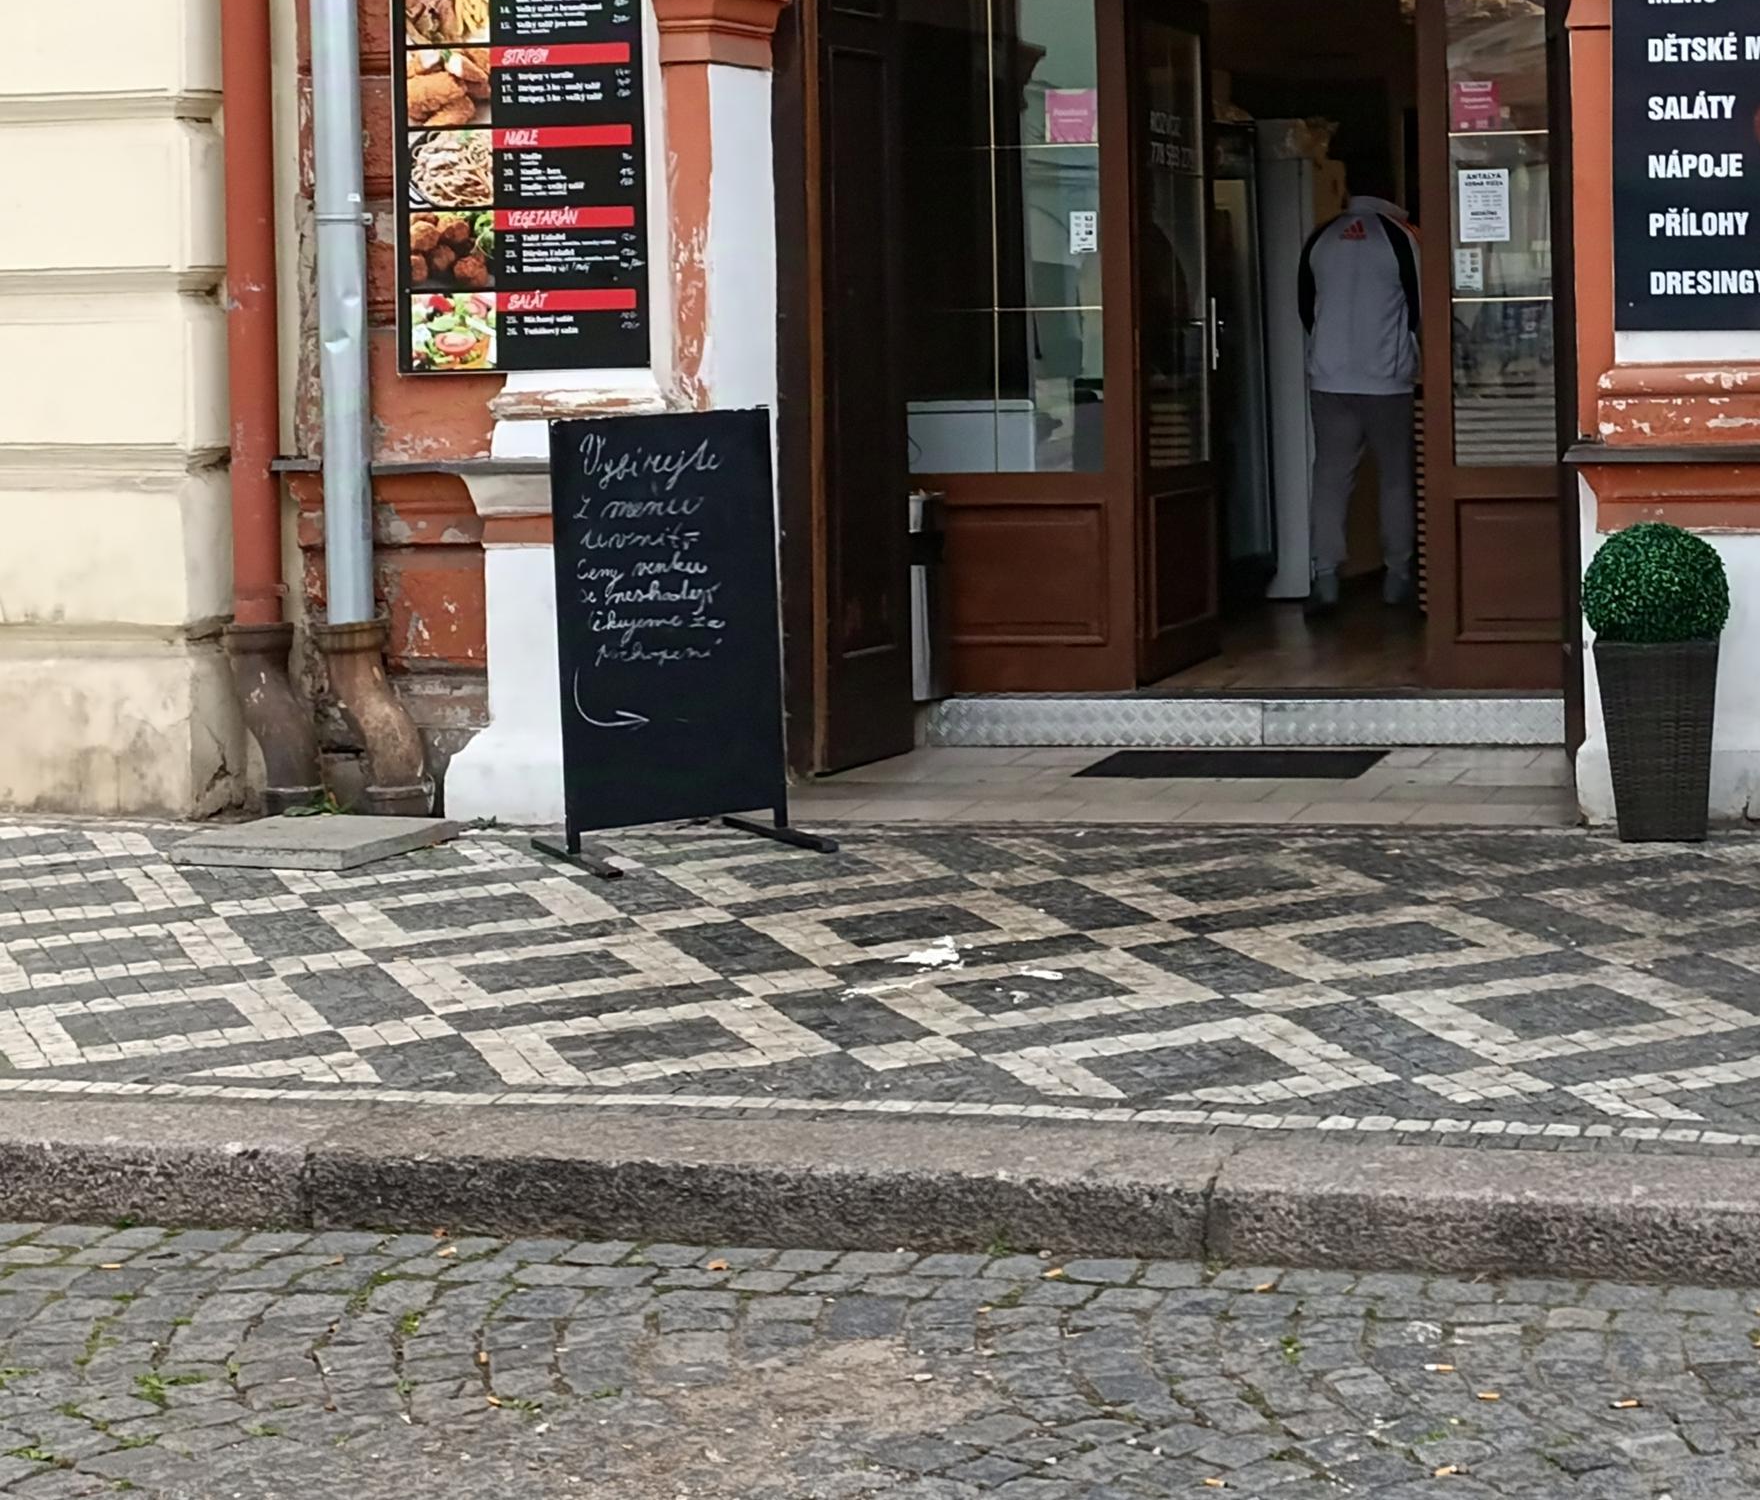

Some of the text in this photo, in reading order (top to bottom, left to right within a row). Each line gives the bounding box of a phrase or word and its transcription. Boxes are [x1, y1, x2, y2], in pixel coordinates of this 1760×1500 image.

[1647, 31, 1737, 62] DĚTSKÉ
[1648, 91, 1736, 120] SALÁTY
[1648, 150, 1743, 178] NÁPOJE
[1649, 207, 1749, 237] PŘÍLOHY
